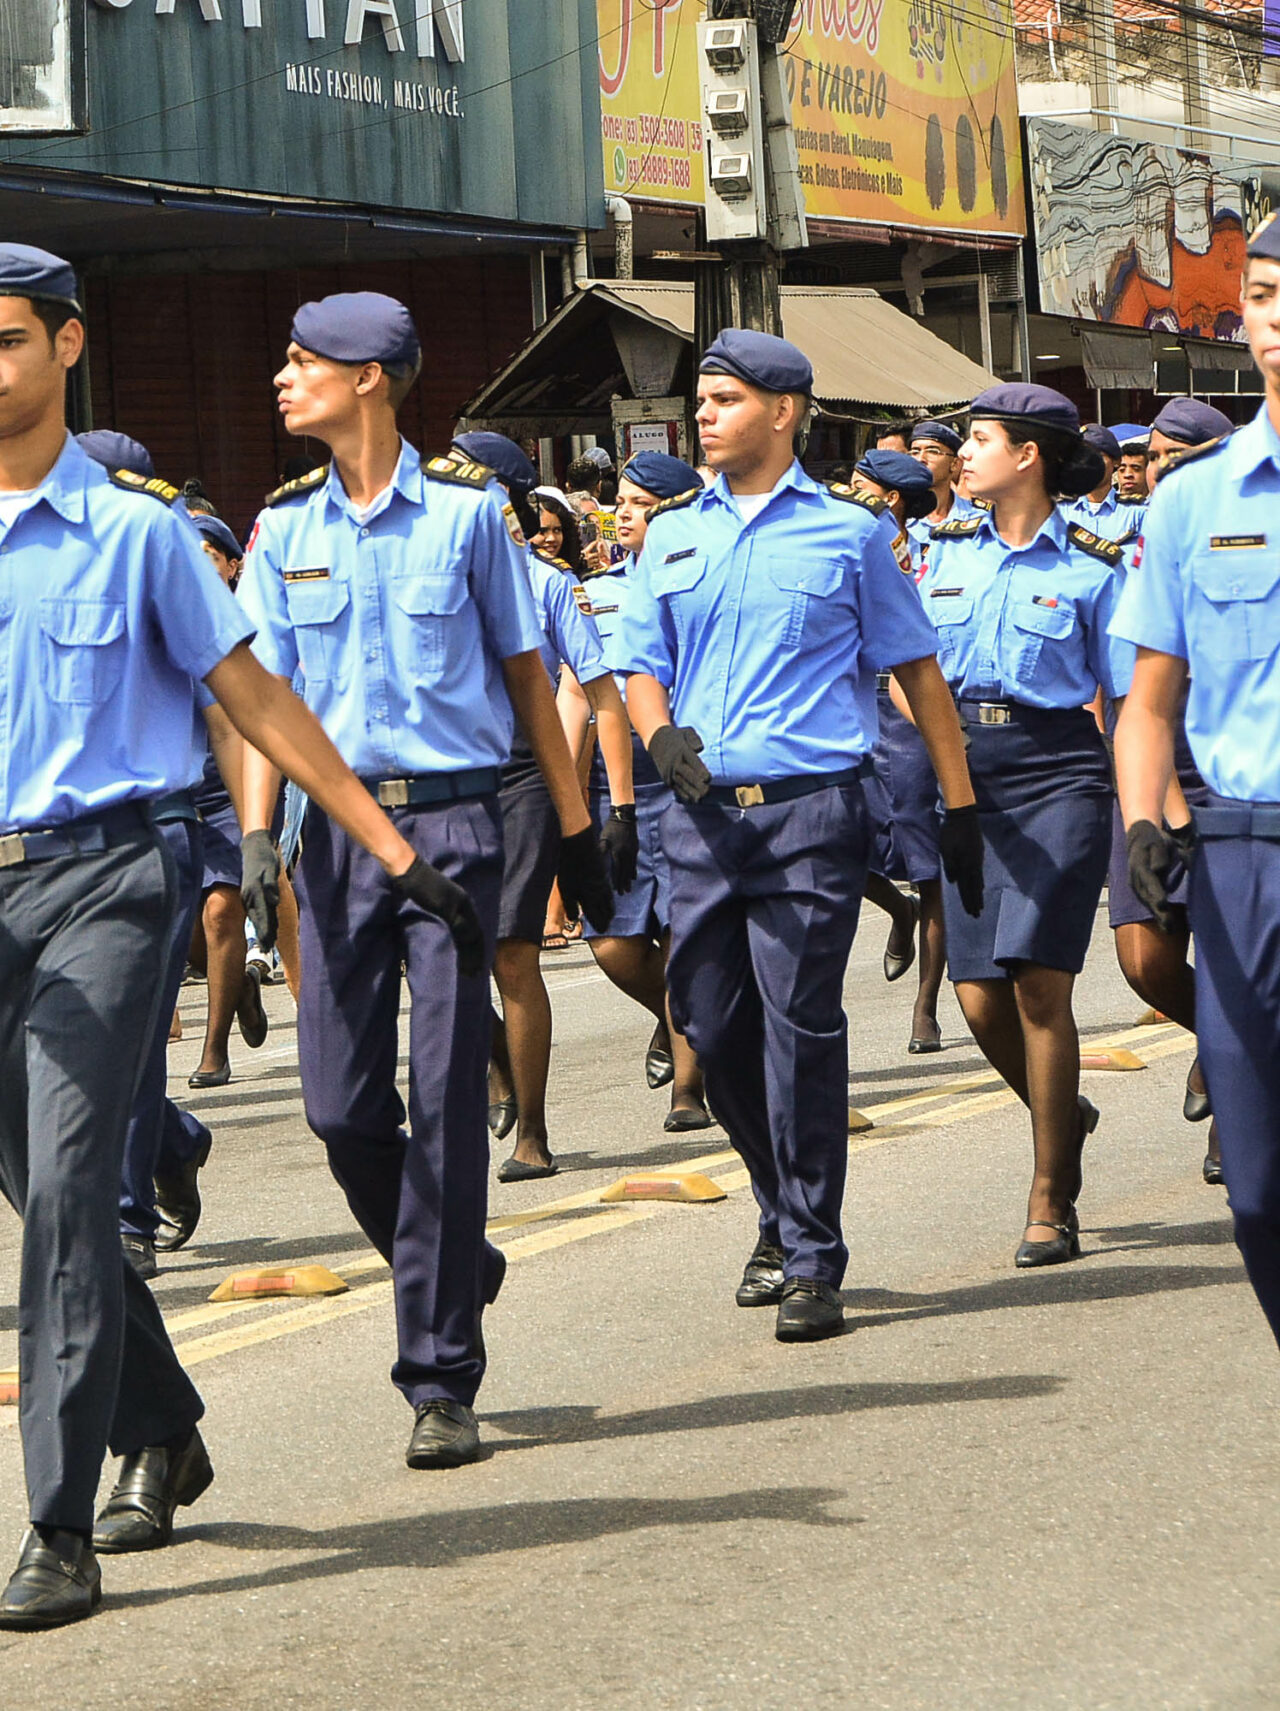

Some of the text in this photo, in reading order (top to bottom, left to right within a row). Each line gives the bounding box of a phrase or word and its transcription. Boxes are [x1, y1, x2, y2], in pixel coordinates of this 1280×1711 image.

[285, 62, 465, 118] MAIS FASHION, MAIS VOCÊ.
[801, 59, 812, 107] E
[818, 61, 887, 119] VAREJO
[819, 134, 830, 153] em
[841, 166, 880, 193] Eletrônicos
[881, 175, 886, 194] e
[886, 172, 903, 196] Mais
[632, 431, 664, 439] ALUGO
